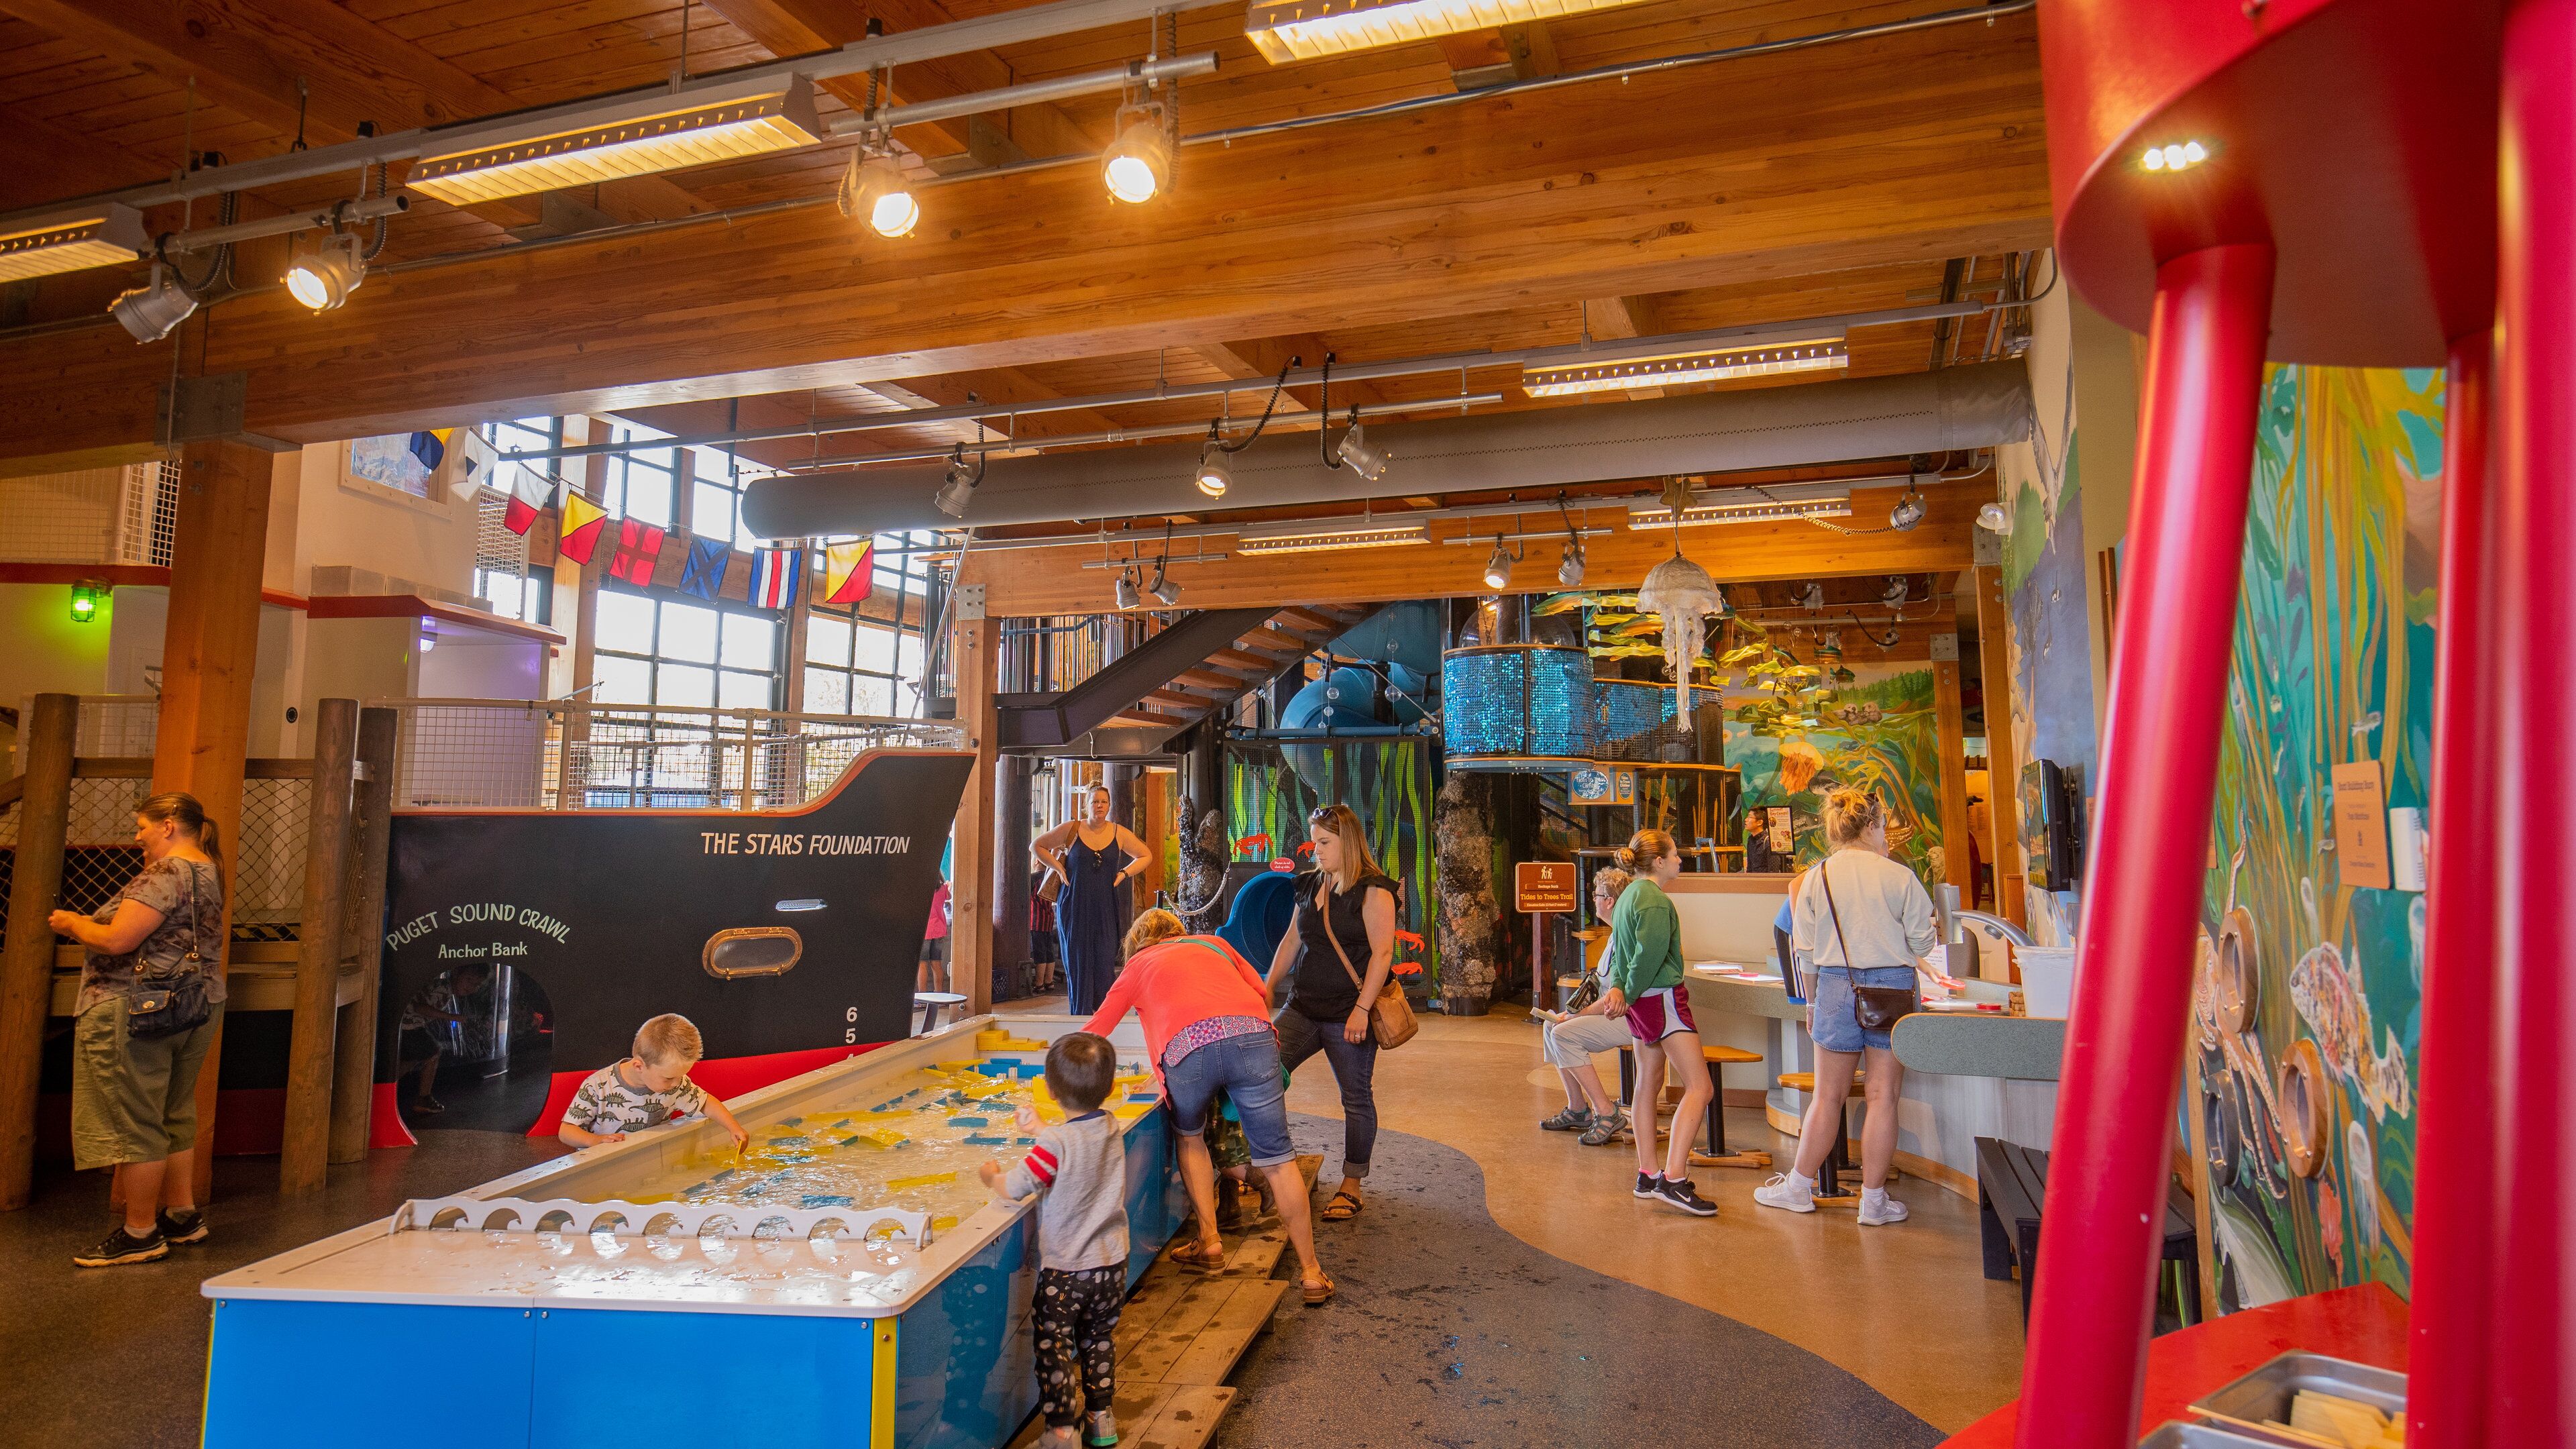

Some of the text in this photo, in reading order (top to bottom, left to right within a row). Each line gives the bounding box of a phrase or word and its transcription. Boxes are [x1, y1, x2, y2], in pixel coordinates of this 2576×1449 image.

[701, 832, 910, 855] THE STARS FOUNDATION
[386, 903, 570, 951] PUGET SOUND CRAWL
[438, 941, 528, 959] Anchor Bank
[847, 1006, 857, 1022] 6
[845, 1028, 856, 1044] 5
